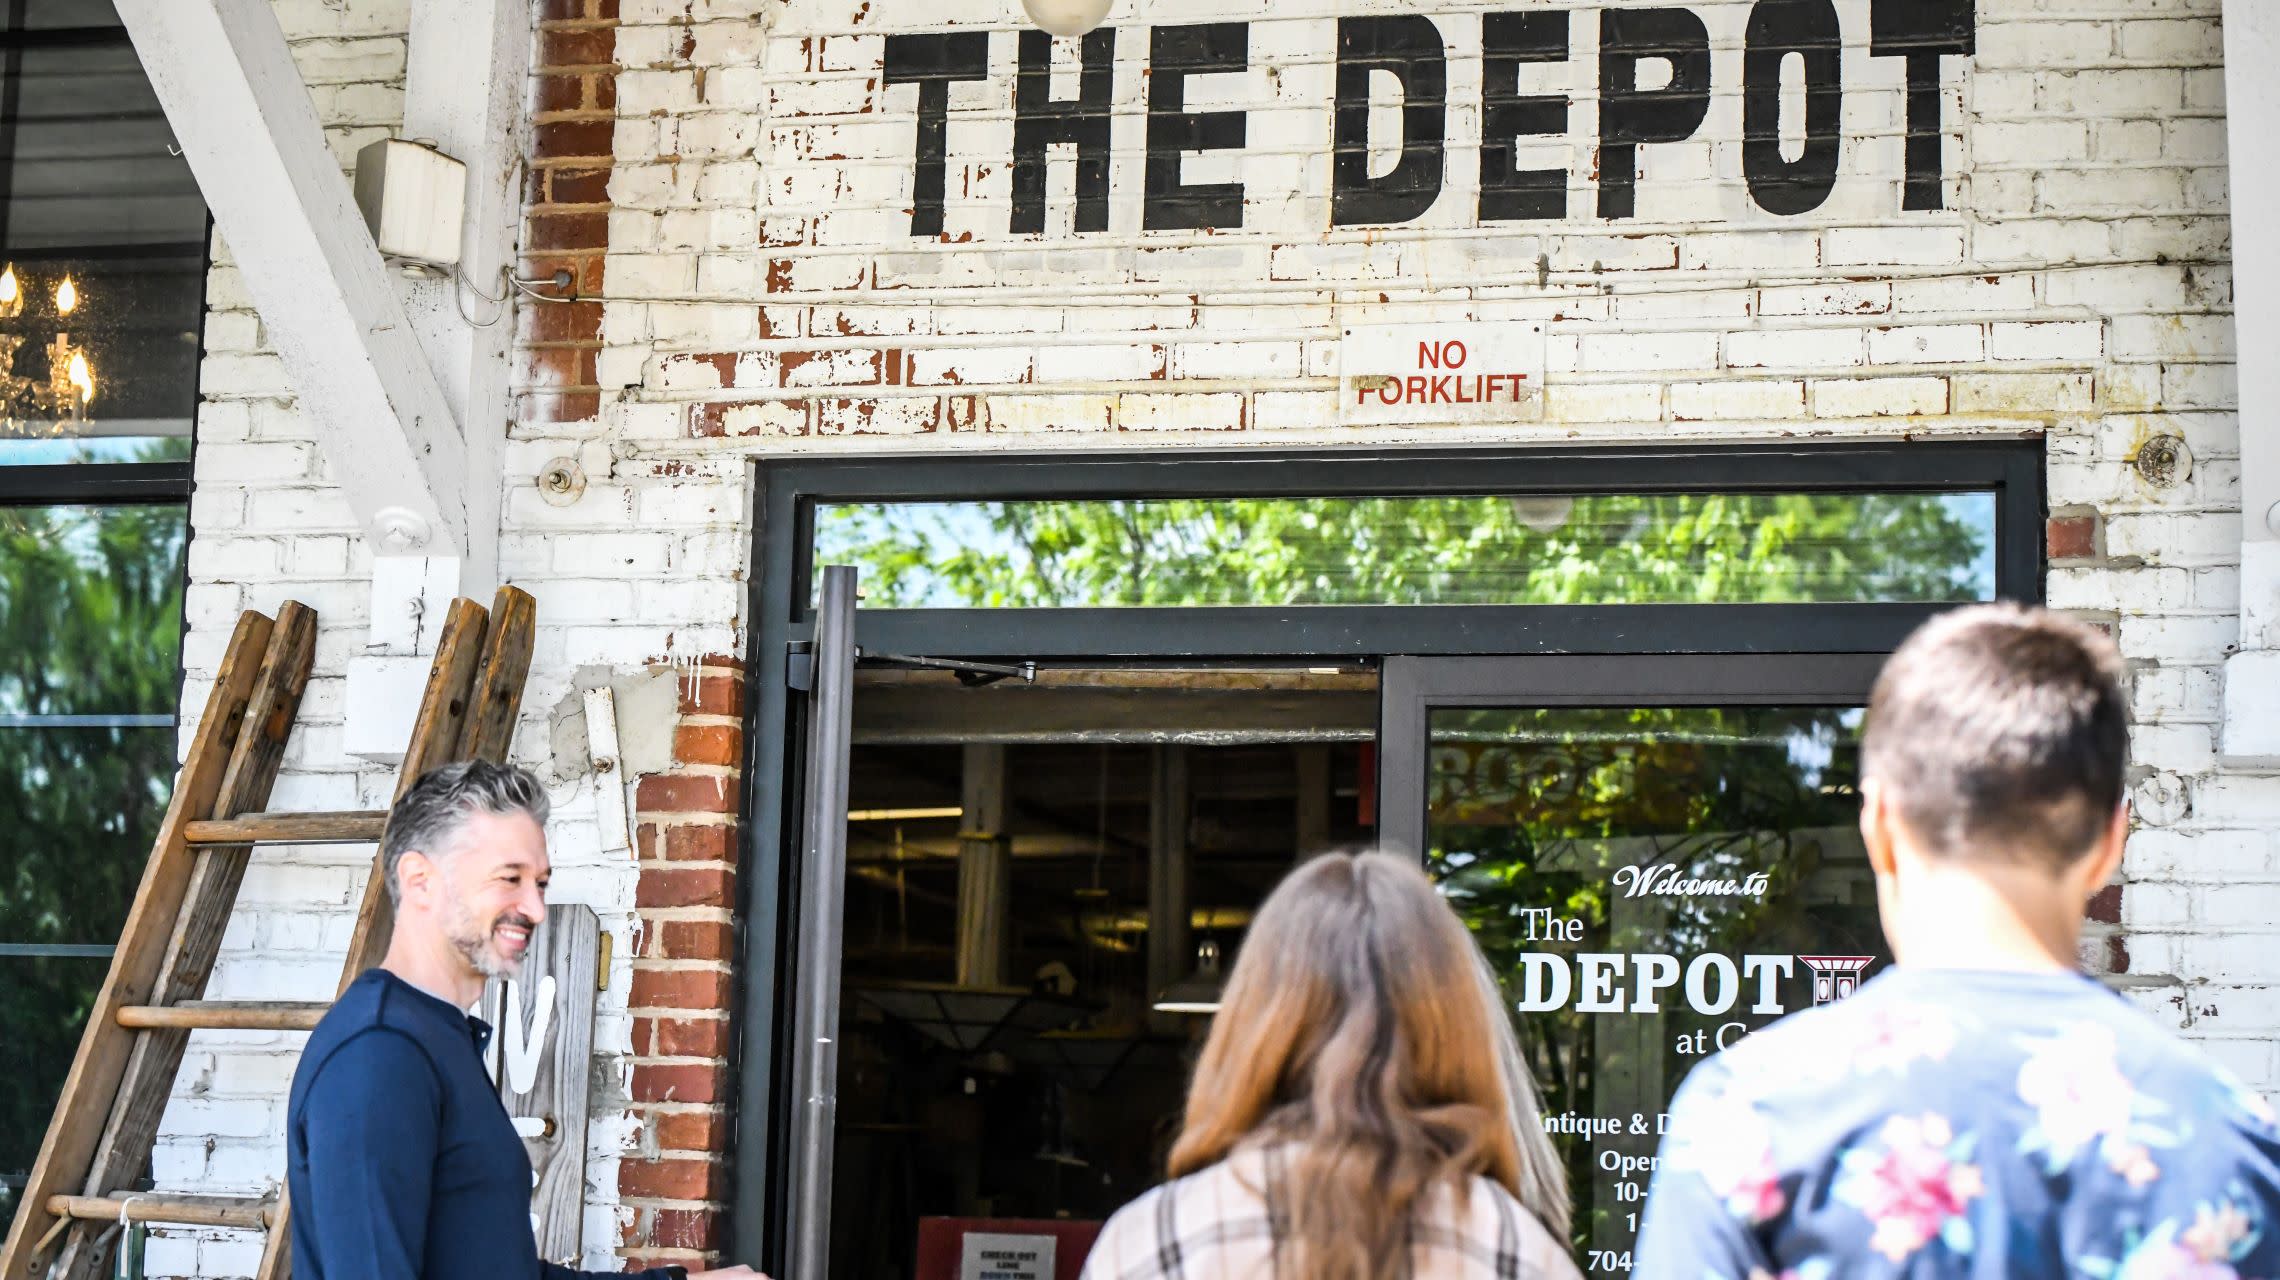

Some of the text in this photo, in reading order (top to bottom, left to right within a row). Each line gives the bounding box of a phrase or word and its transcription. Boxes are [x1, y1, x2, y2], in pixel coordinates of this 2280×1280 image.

[883, 0, 1976, 237] THE DEPOT
[1418, 340, 1467, 369] NO
[1612, 863, 1770, 898] Welcome to
[1520, 907, 1584, 942] The
[1518, 952, 1794, 1015] DEPOT
[1675, 1028, 1708, 1054] at
[1544, 1111, 1622, 1141] ntique
[1629, 1113, 1649, 1135] &
